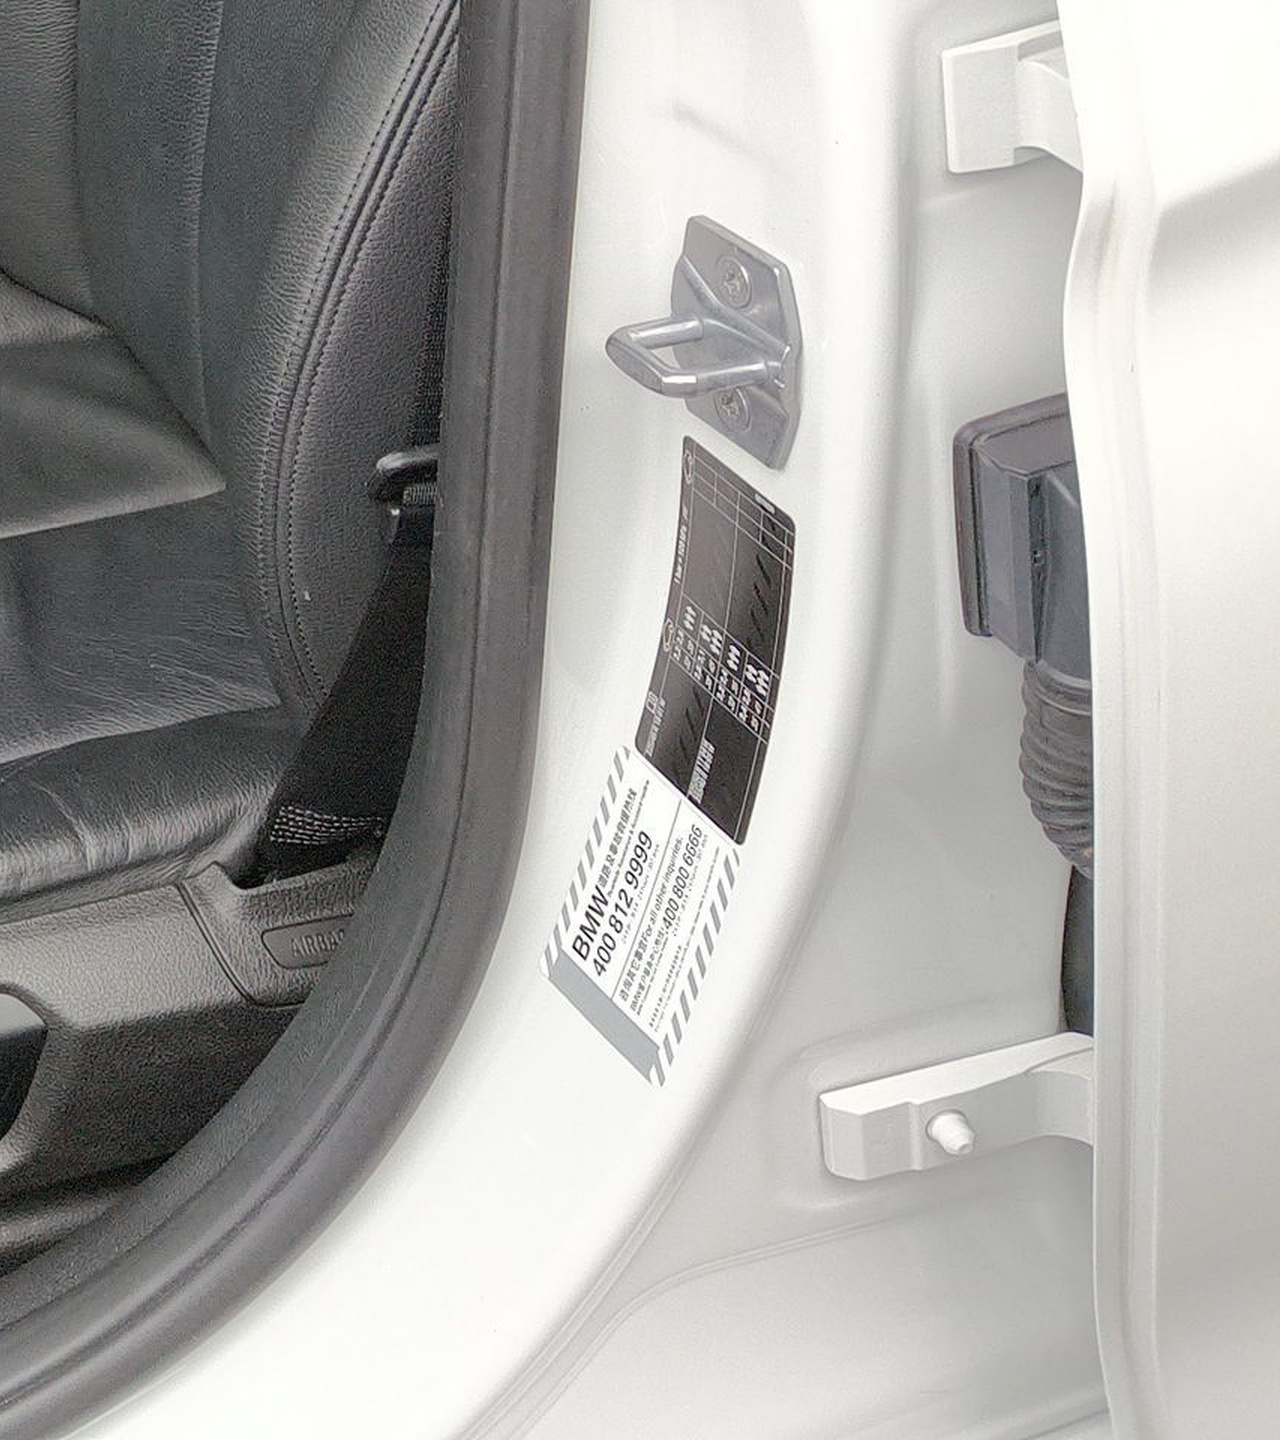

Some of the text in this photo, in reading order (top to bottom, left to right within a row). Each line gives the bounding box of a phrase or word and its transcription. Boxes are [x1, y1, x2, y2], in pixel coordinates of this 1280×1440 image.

[593, 932, 617, 977] 400
[608, 888, 634, 934] 812
[624, 830, 653, 890] 9999
[653, 884, 668, 912] other
[662, 897, 680, 931] 400
[671, 865, 690, 899] 800
[684, 823, 703, 866] 6666
[571, 884, 610, 961] BMW
[649, 909, 659, 927] all
